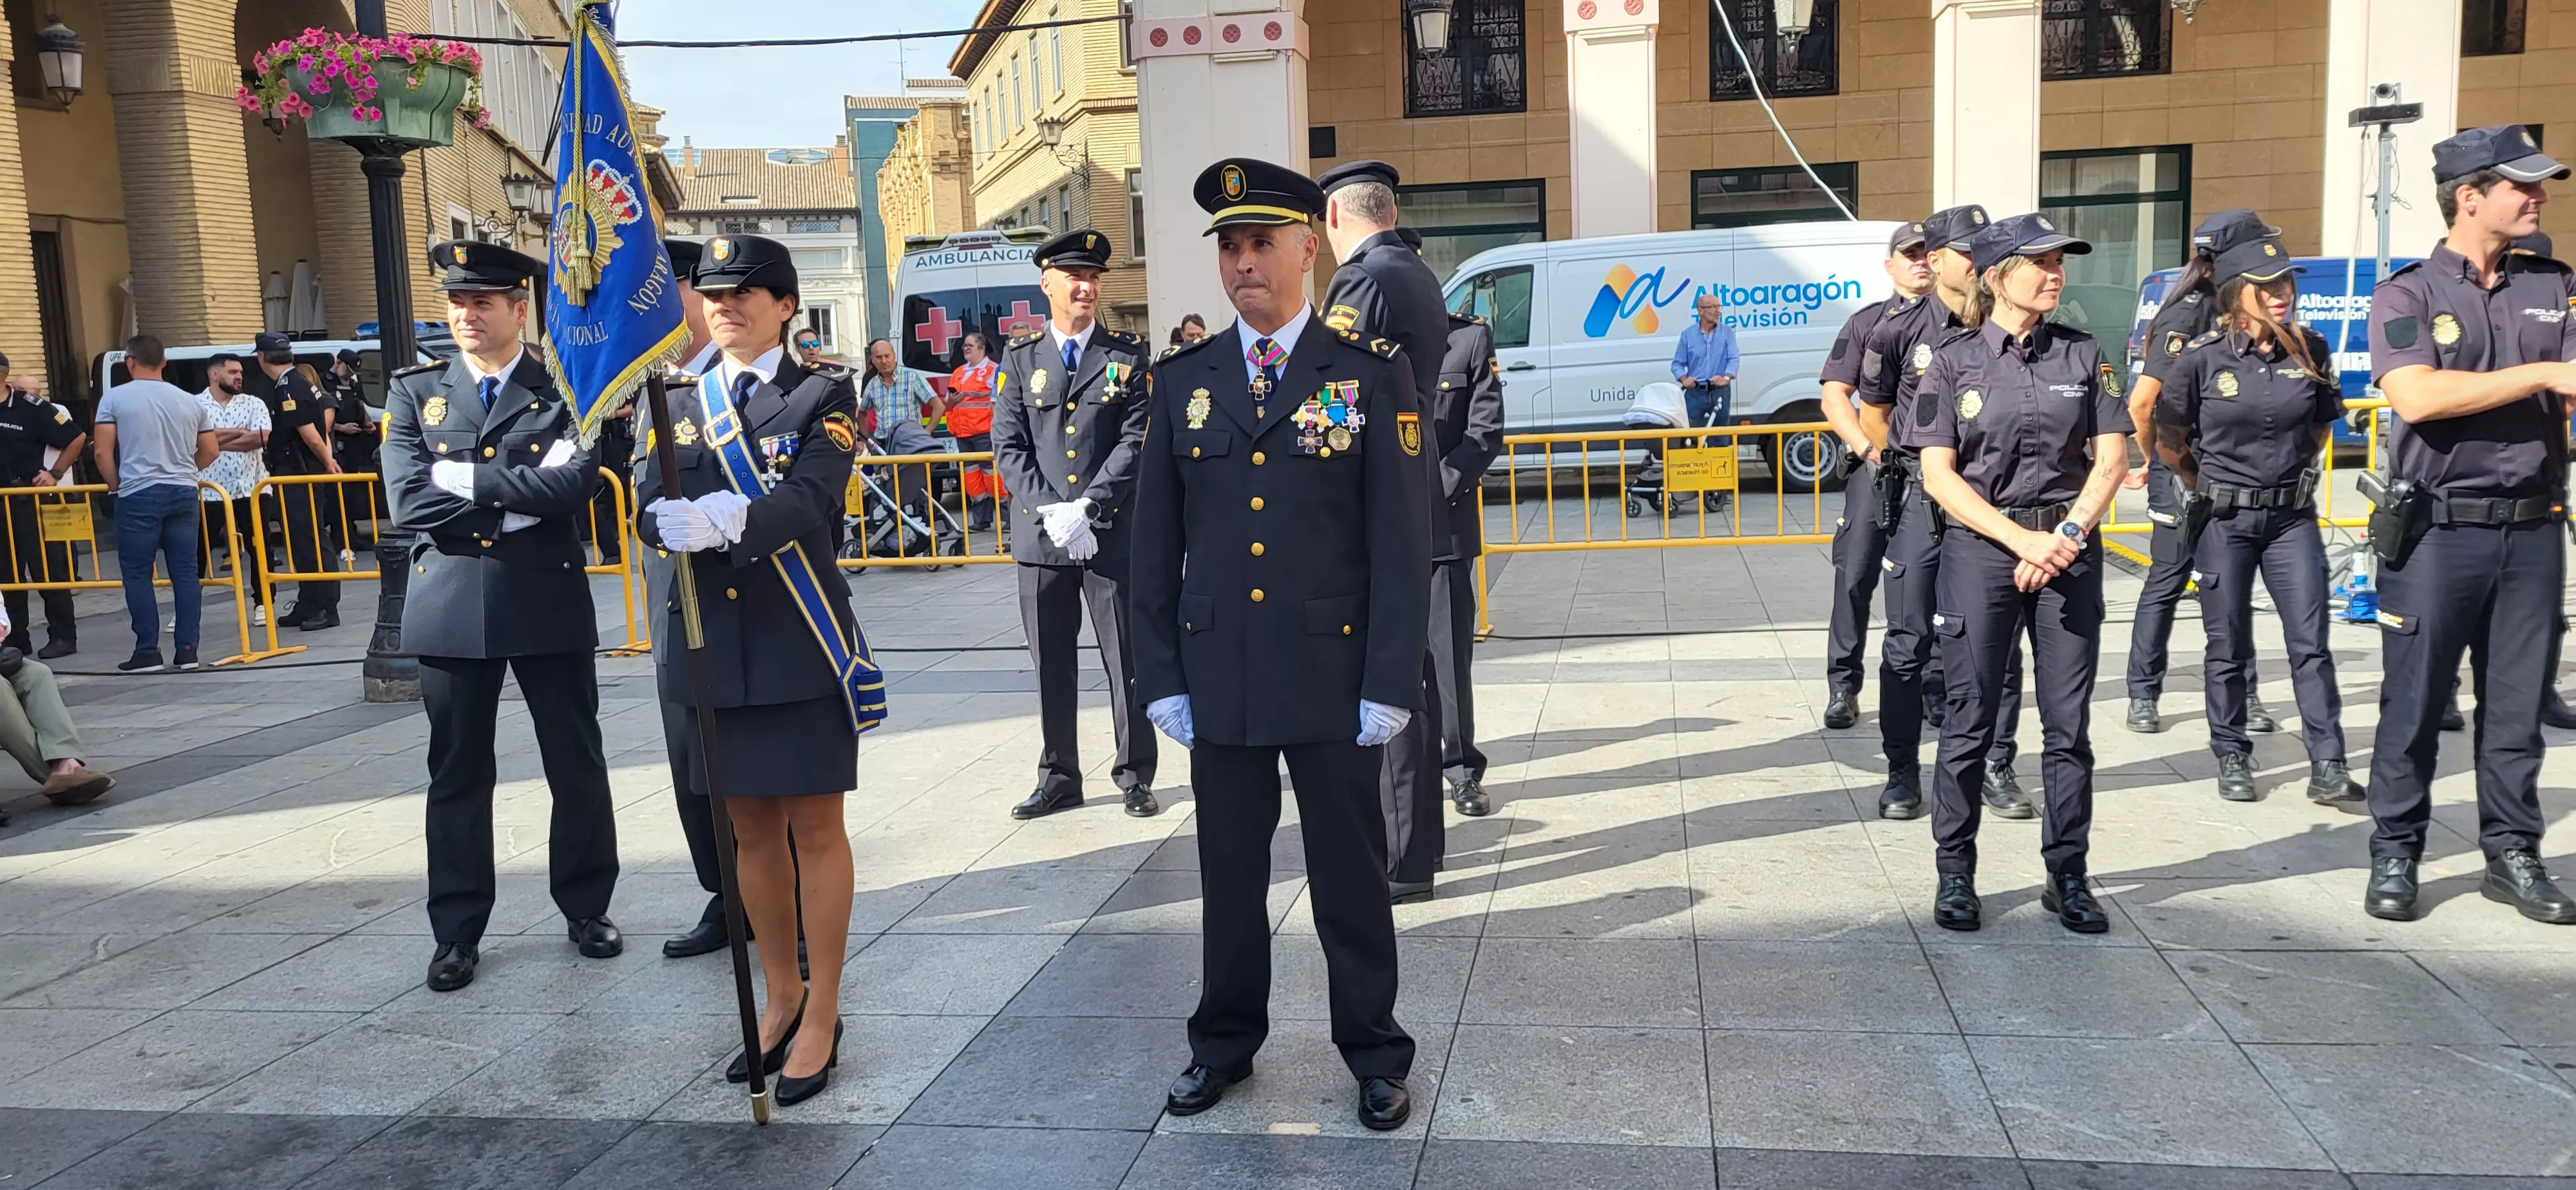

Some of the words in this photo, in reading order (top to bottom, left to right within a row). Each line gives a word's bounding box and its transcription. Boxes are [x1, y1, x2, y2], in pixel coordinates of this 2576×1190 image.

[916, 249, 1034, 268] AMBULANCIA
[2297, 308, 2367, 321] Televisón
[1590, 385, 1644, 402] Unida
